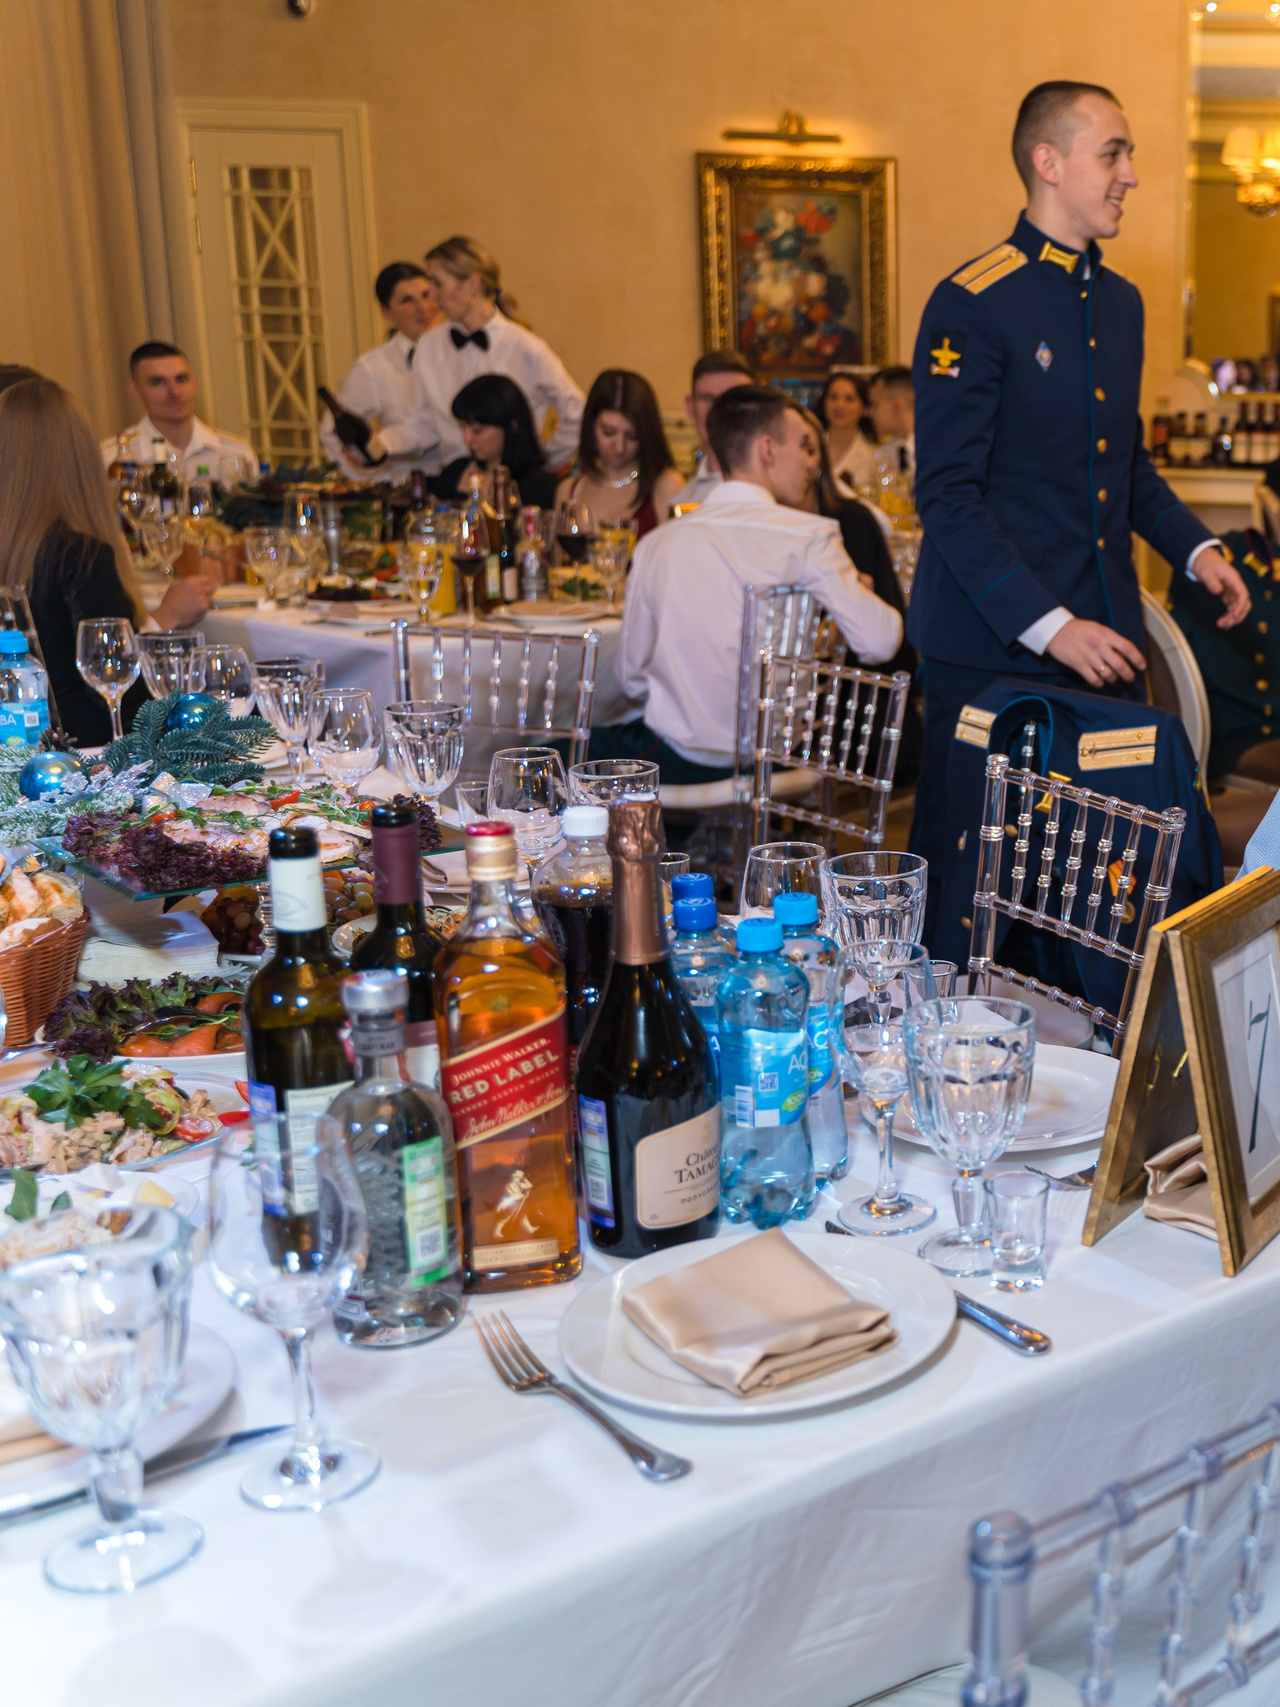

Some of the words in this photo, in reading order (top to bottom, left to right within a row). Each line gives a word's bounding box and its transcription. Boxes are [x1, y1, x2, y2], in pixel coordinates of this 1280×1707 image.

[449, 1080, 490, 1104] RED
[494, 1050, 560, 1086] LABEL
[453, 1059, 502, 1086] JOHNNIE
[492, 1083, 525, 1101] SCOTCH
[528, 1066, 561, 1085] WHISKY
